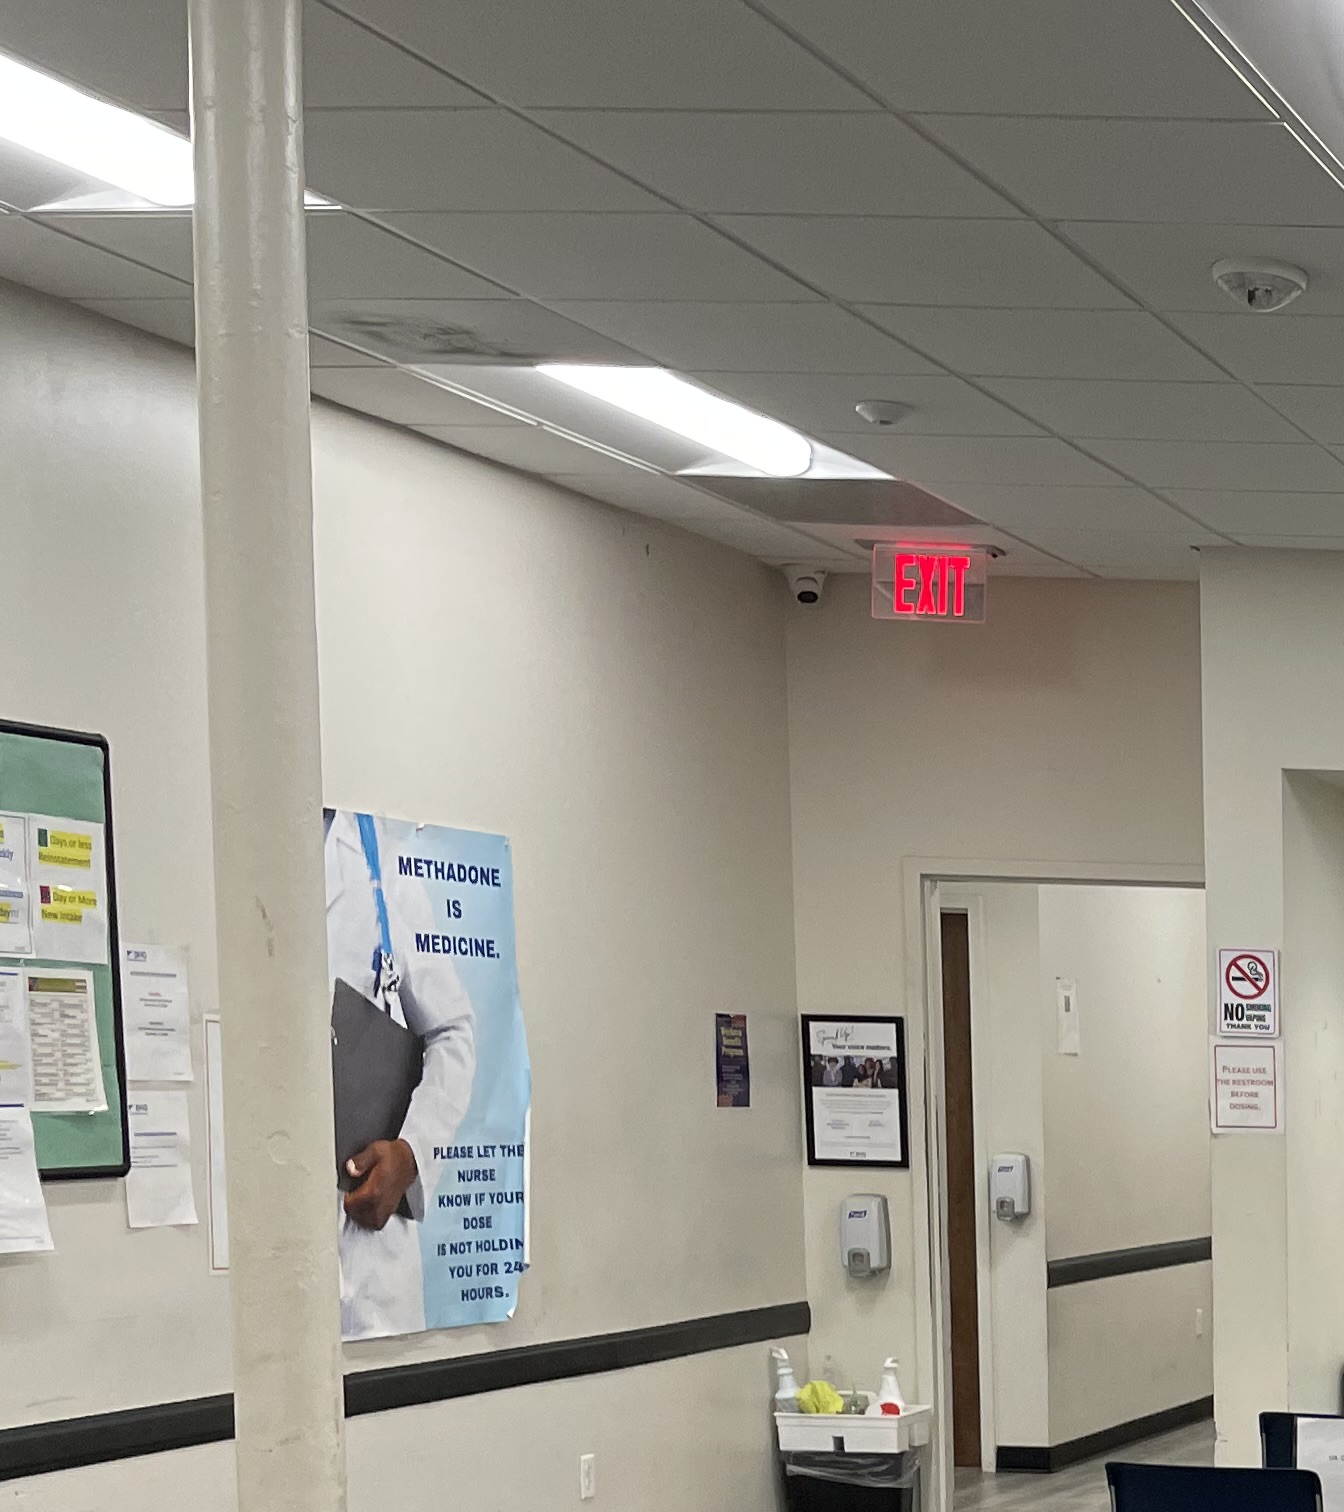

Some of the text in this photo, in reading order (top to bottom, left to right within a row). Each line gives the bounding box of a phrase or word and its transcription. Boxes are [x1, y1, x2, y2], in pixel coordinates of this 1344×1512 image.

[894, 553, 971, 617] EXIT
[398, 855, 501, 888] METHADONE
[447, 899, 462, 919] IS
[415, 933, 500, 959] MEDICINE.
[1224, 1003, 1245, 1021] NO
[434, 1144, 525, 1160] PLEASE LET THE
[458, 1169, 496, 1183] NURSE
[438, 1191, 525, 1208] KNOW IF YOUR
[463, 1216, 493, 1230] DOSE
[437, 1243, 446, 1256] IS
[450, 1241, 472, 1255] NOT
[449, 1265, 473, 1279] YOU
[476, 1262, 499, 1277] FOR
[461, 1285, 510, 1302] HOURS.
